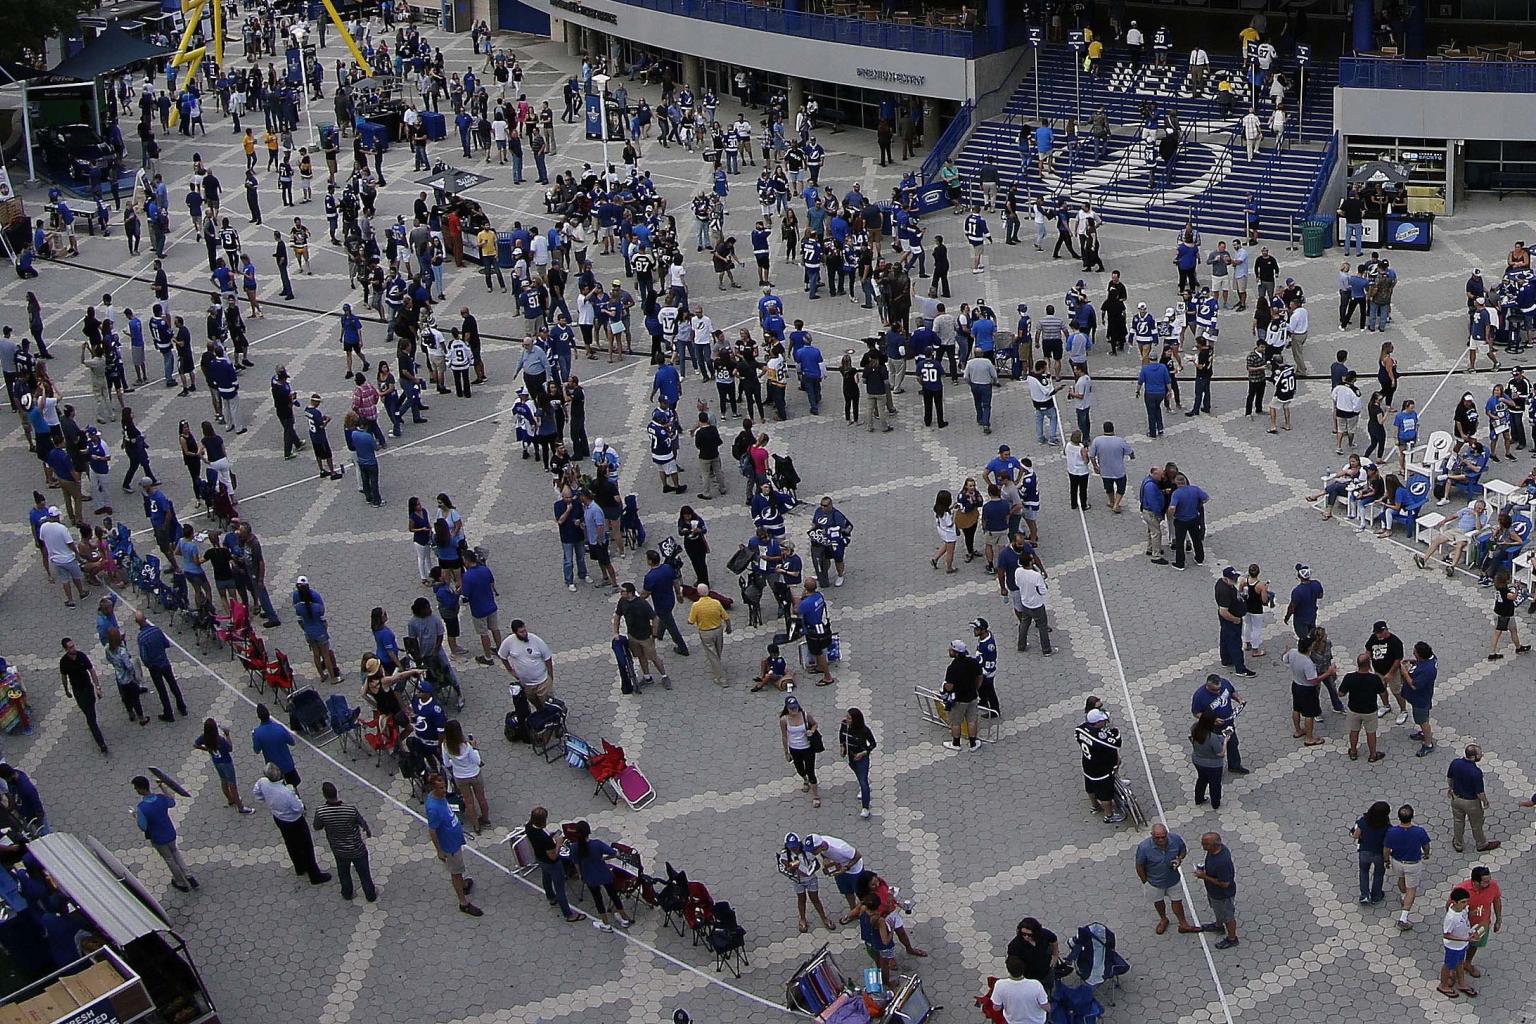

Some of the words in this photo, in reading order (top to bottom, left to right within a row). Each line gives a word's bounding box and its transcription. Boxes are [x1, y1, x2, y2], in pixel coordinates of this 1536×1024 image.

[728, 139, 739, 148] 30
[224, 234, 232, 245] 9
[804, 250, 815, 261] 77
[636, 261, 649, 272] 87
[456, 350, 464, 362] 9
[921, 368, 938, 382] 30
[1280, 376, 1295, 393] 30
[1081, 743, 1091, 760] 9
